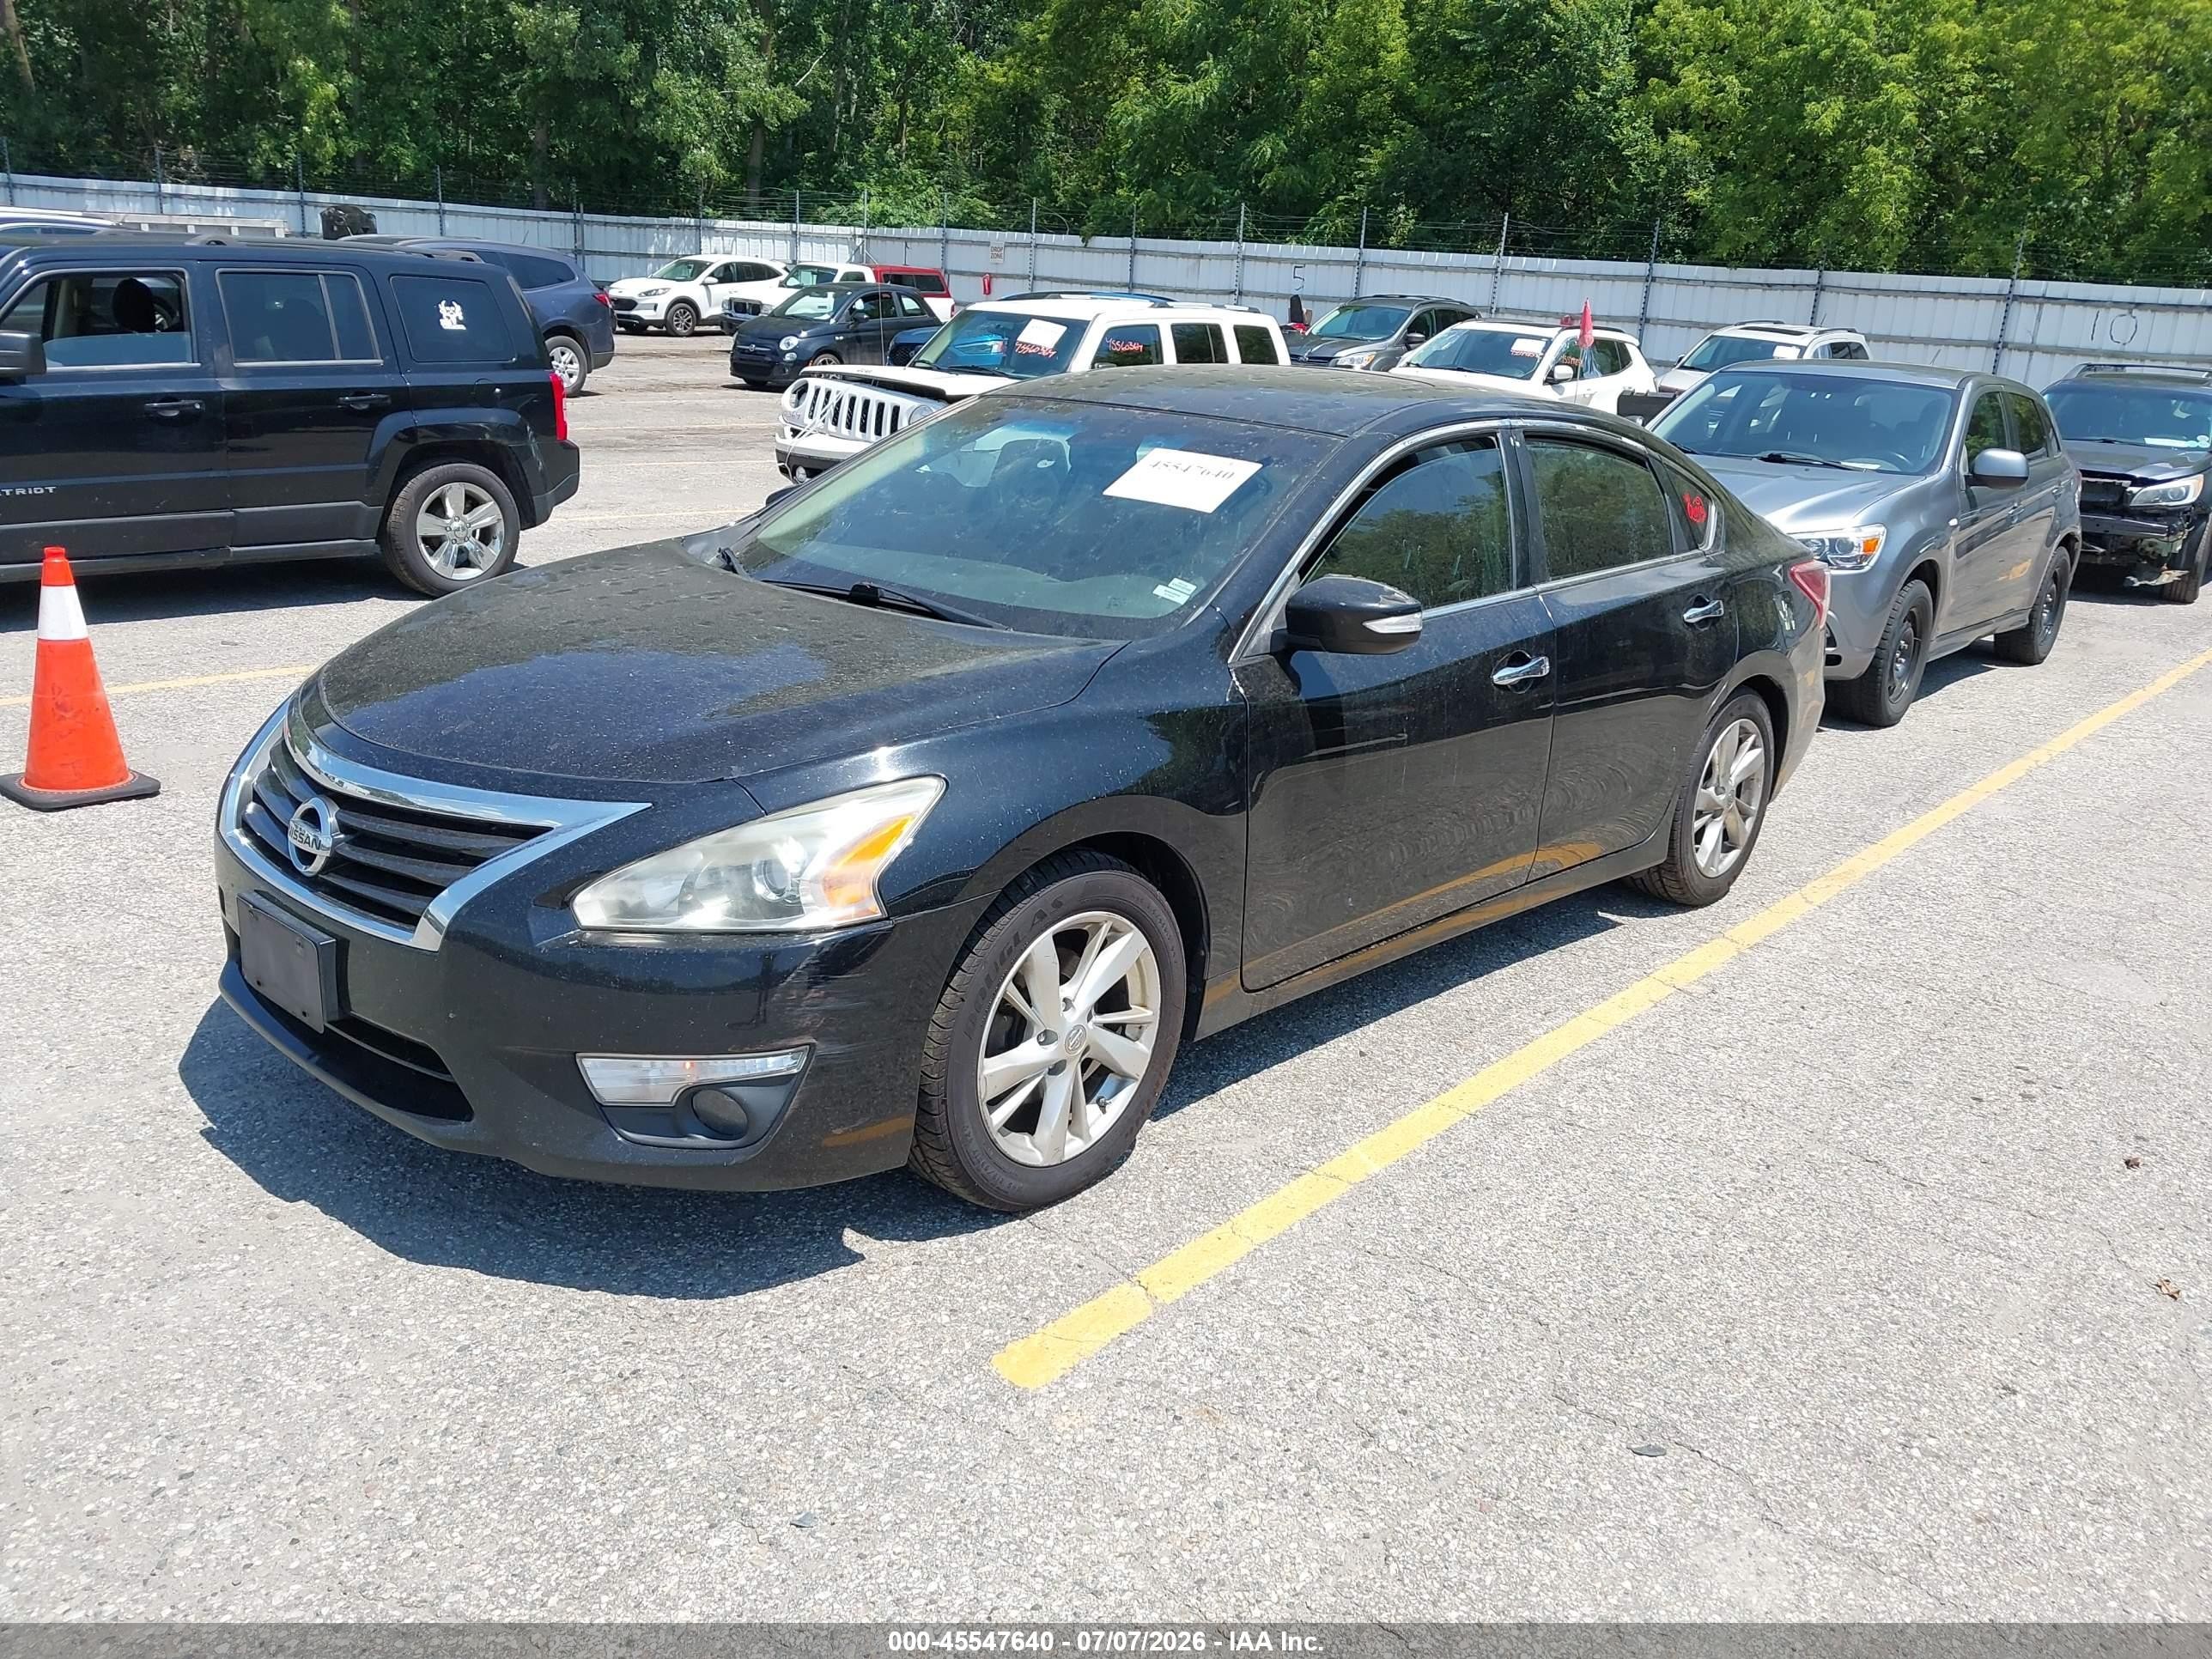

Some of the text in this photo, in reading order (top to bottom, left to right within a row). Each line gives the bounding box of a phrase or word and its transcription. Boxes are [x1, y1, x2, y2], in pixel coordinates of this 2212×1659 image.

[1293, 264, 1305, 291] 5
[2090, 310, 2138, 345] 10
[0, 486, 57, 496] TRIOT
[289, 825, 322, 851] NISSAN
